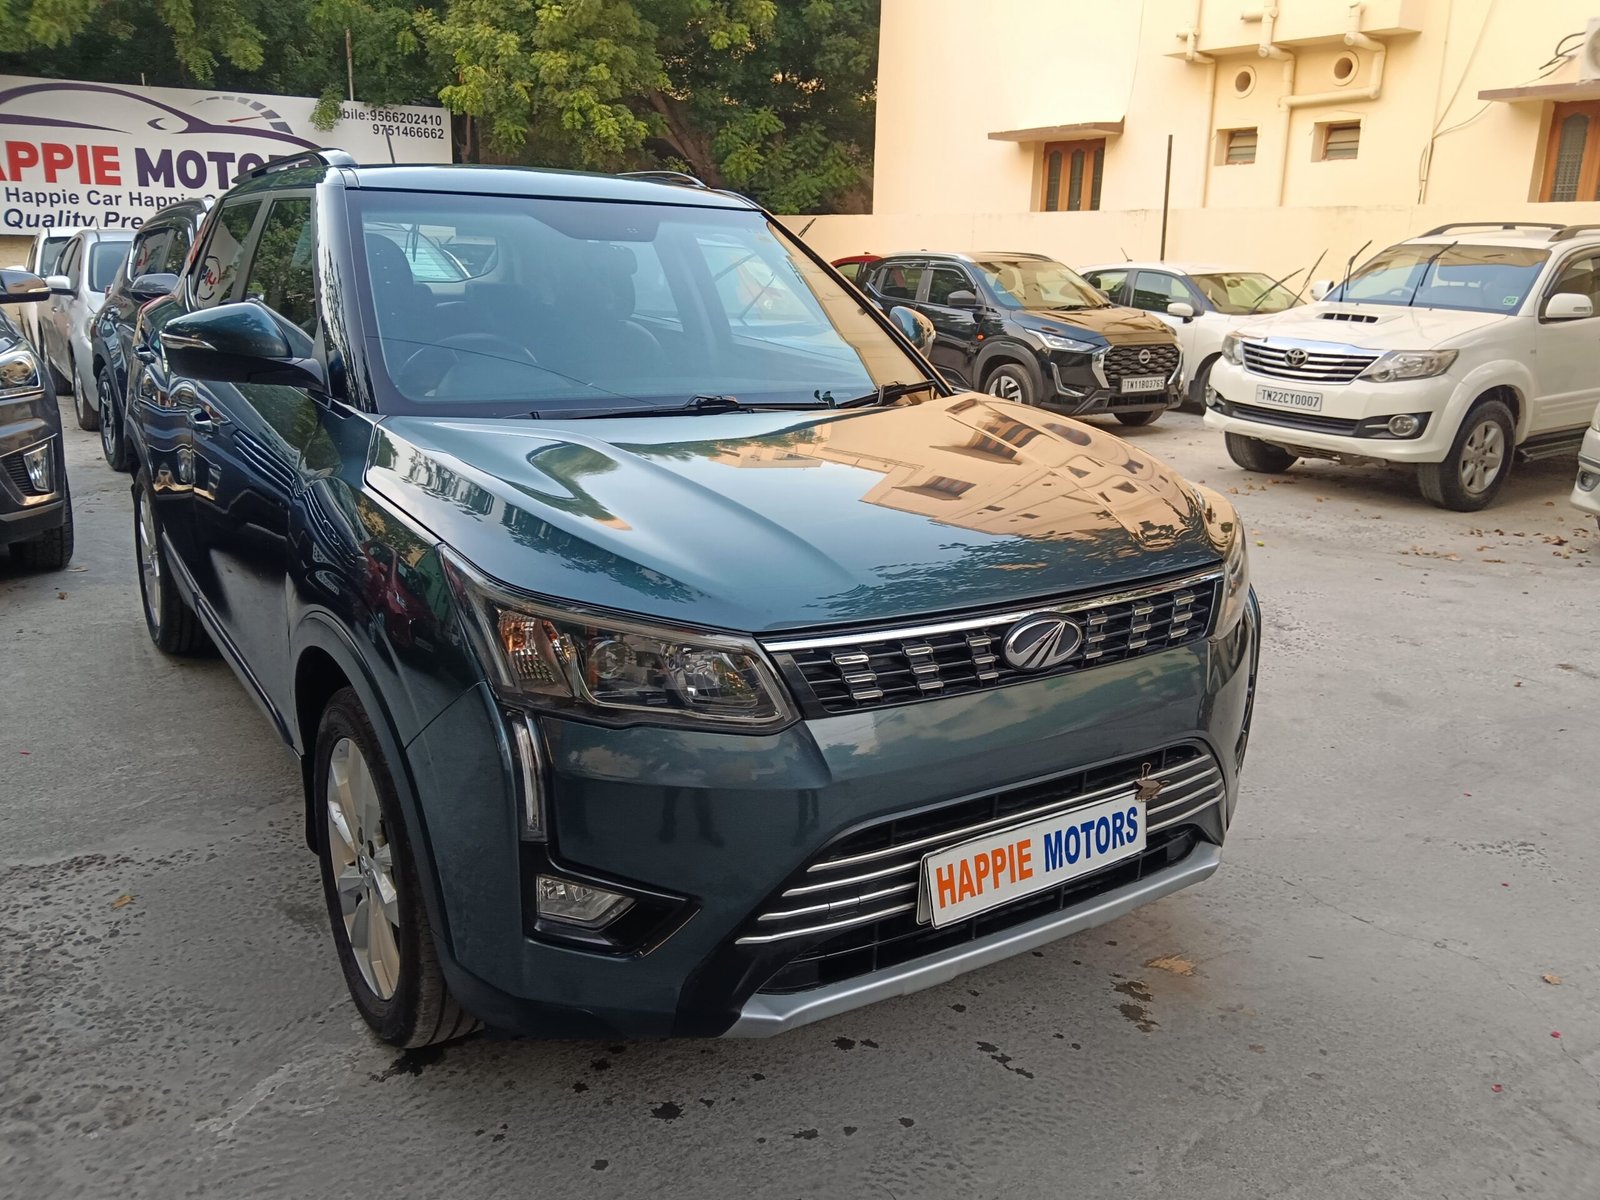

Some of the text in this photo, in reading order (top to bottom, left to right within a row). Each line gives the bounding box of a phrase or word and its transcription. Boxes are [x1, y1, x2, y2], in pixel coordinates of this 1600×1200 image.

[341, 107, 442, 126] bile:9566202410
[372, 123, 445, 140] 9751466662
[0, 140, 300, 190] PPIE MOTO
[5, 186, 80, 207] Happie
[86, 189, 122, 206] Car
[3, 208, 96, 229] Quality
[1262, 389, 1320, 407] TN22CY0007
[935, 806, 1139, 909] HAPPIE MOTORS
